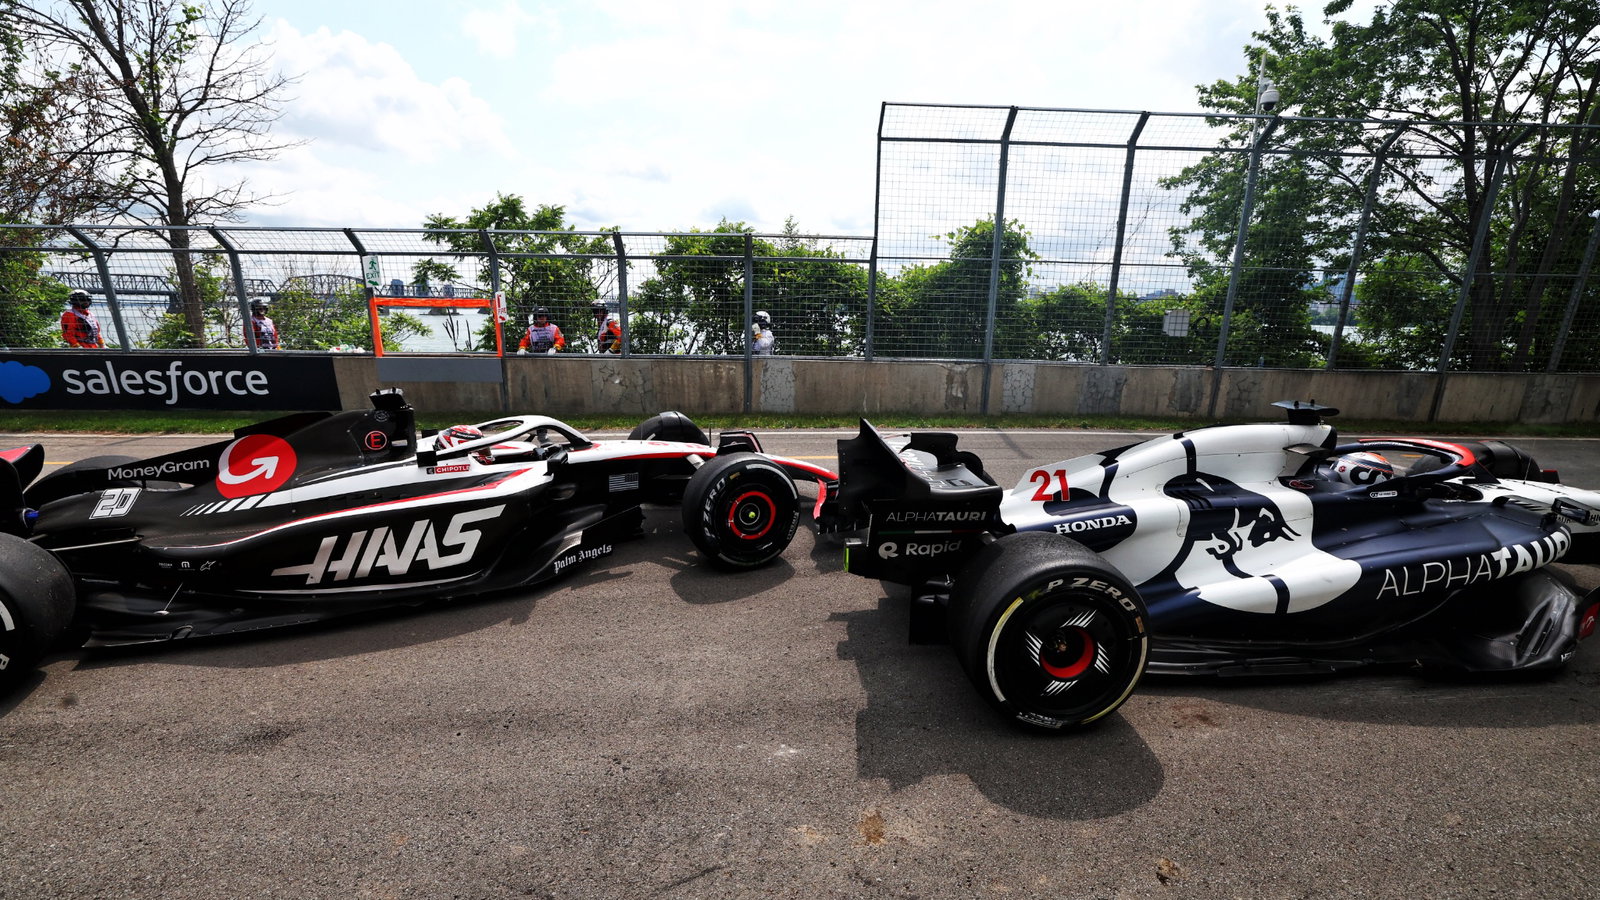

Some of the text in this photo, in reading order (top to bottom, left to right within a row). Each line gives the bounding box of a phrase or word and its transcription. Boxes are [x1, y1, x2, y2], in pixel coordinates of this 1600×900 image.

[366, 271, 380, 280] EXIT
[62, 360, 270, 405] salesforce
[107, 459, 210, 481] MoneyGram
[1029, 469, 1070, 502] 21
[88, 487, 143, 520] 20
[885, 511, 987, 522] ALPHATAURI
[1053, 515, 1132, 535] HONDA
[270, 503, 507, 586] HAAS
[553, 544, 612, 575] Palm Angels
[905, 539, 962, 558] Rapid
[1047, 577, 1138, 612] P ZERO
